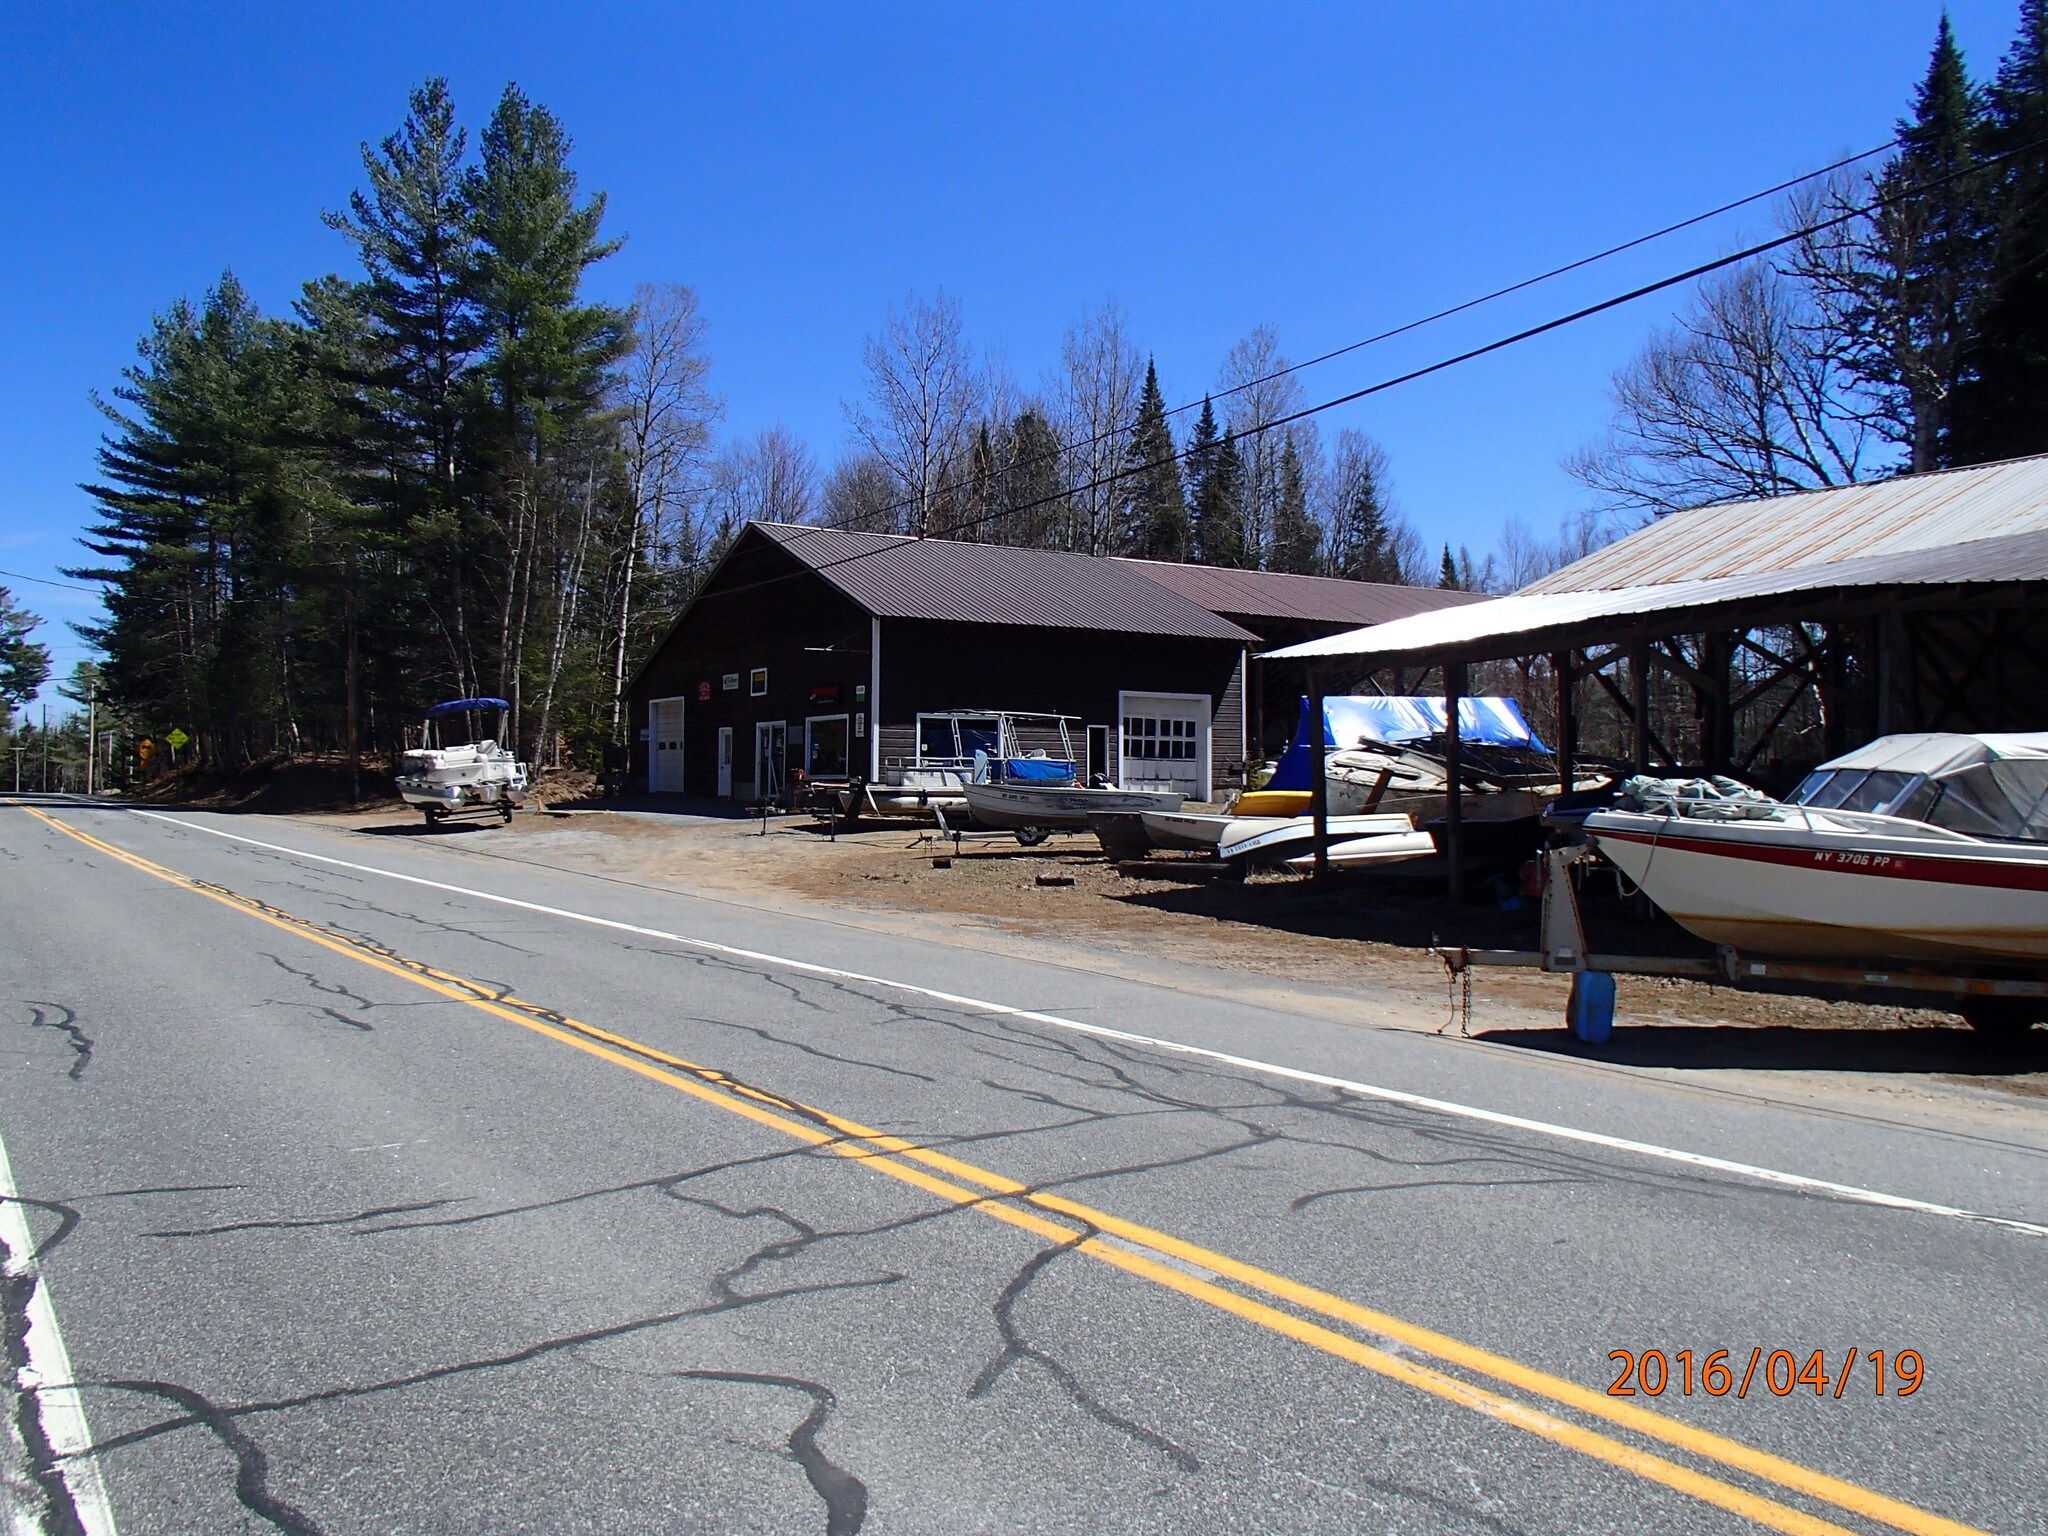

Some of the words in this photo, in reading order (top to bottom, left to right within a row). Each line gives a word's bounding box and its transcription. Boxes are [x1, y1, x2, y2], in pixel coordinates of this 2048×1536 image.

[1814, 852, 1833, 862] NY
[1836, 853, 1870, 866] 3706
[1872, 856, 1891, 868] PP
